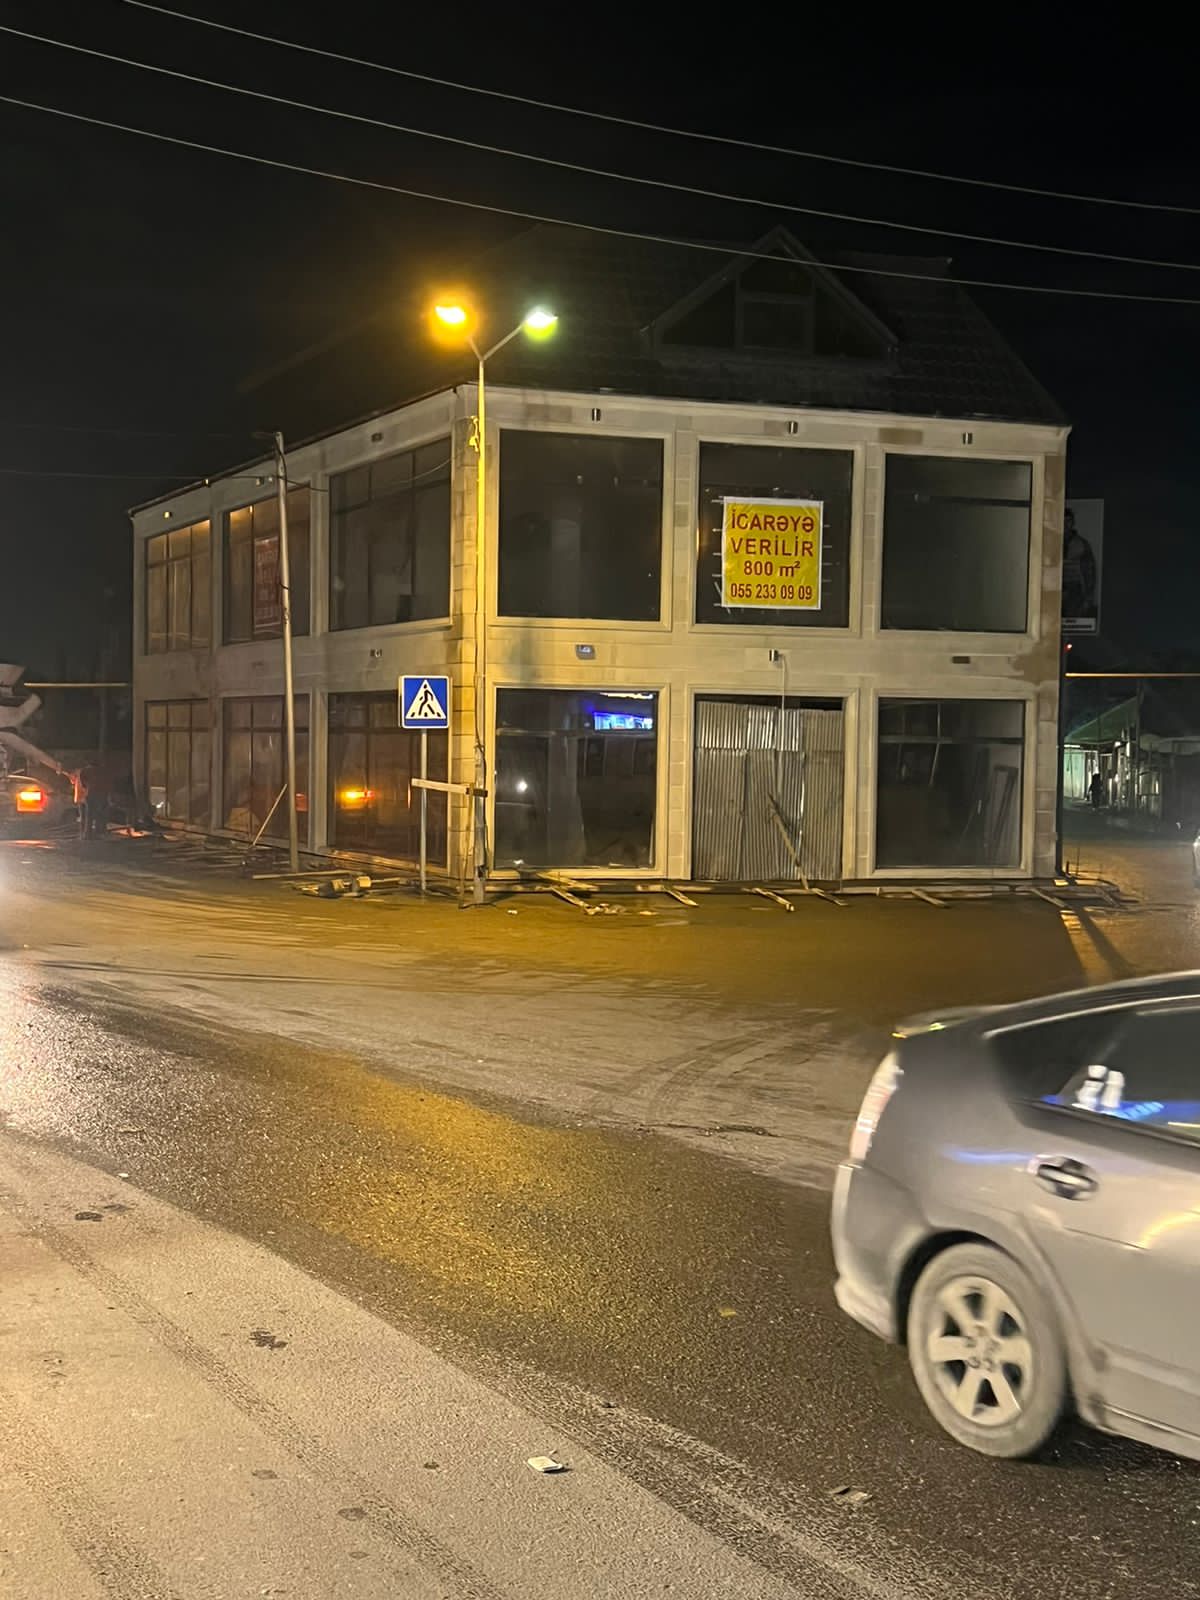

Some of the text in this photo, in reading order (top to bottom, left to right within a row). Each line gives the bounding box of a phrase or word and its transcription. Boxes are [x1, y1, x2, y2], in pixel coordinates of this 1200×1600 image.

[731, 509, 814, 532] İCARƏYƏ
[731, 535, 813, 557] VERİLİR
[744, 561, 800, 577] 800 m²
[731, 583, 812, 600] 055 233 09 09
